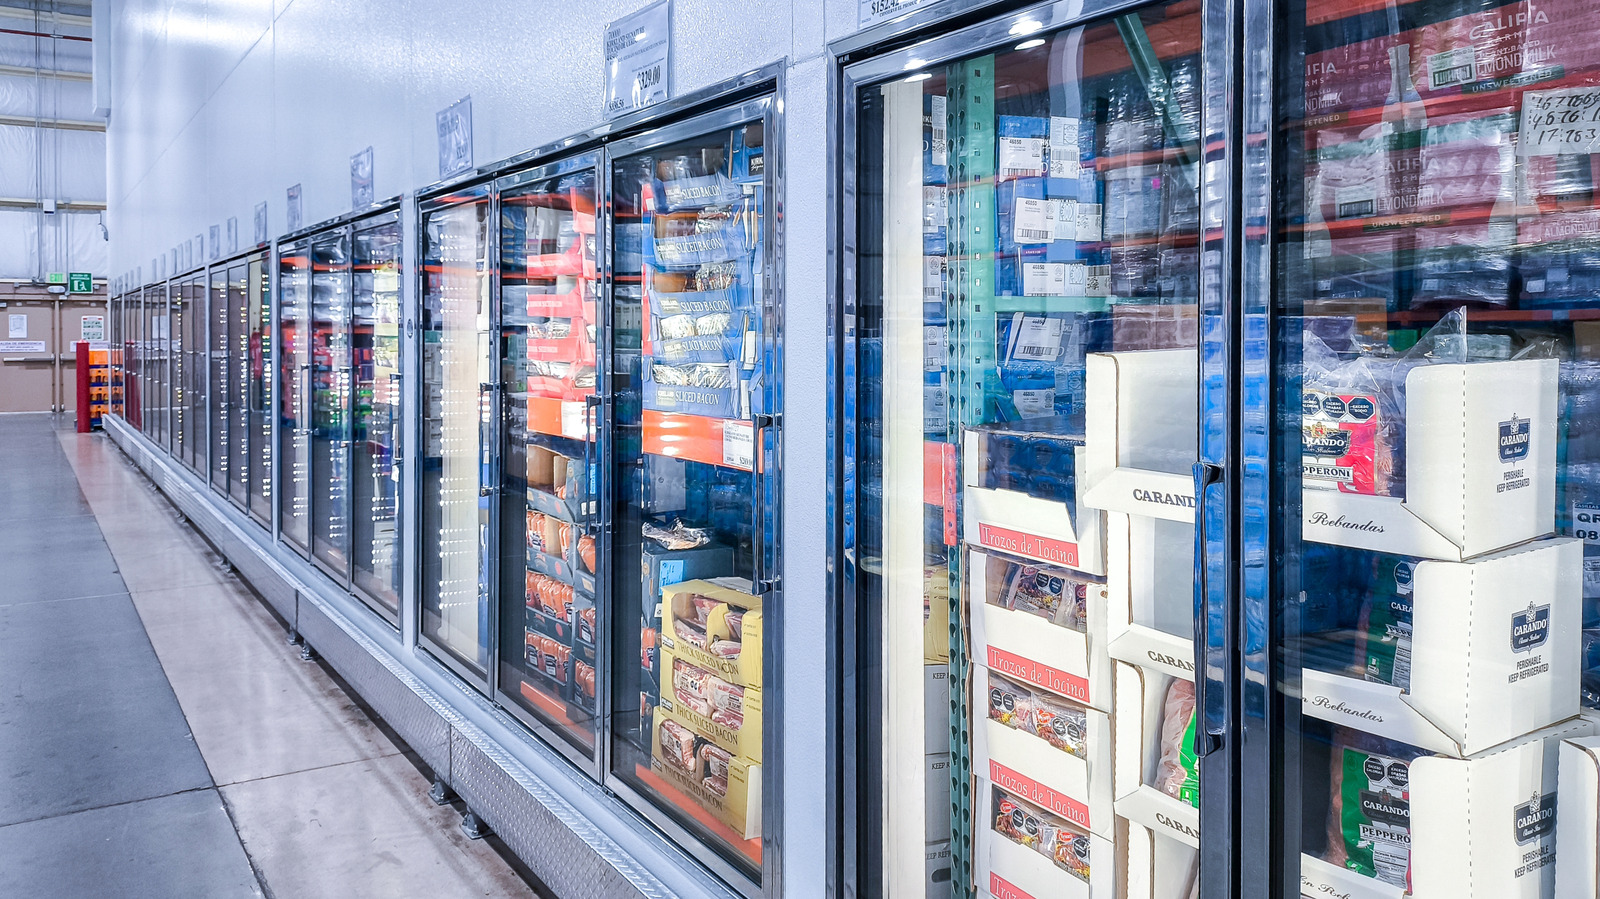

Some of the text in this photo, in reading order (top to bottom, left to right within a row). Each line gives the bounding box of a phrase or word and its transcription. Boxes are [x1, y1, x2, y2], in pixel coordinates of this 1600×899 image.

[1469, 10, 1549, 40] CALIFIA
[1305, 62, 1337, 76] IFIA
[1476, 45, 1557, 75] LMONDMILK
[1384, 157, 1441, 173] ALIFIA
[681, 188, 700, 200] SLICED
[700, 185, 722, 198] BACON
[1377, 188, 1445, 211] LMONDMILK
[676, 240, 697, 254] SLICED
[698, 238, 722, 252] BACON
[680, 301, 704, 312] SLICED
[704, 300, 730, 312] BACON
[700, 340, 722, 352] BACON
[676, 390, 696, 402] SLICED
[696, 394, 720, 405] BACON
[1303, 437, 1345, 448] RANDO
[1501, 432, 1528, 446] CARANDO
[1504, 468, 1524, 482] PERISHABLE
[1496, 478, 1530, 494] KEEP REFRIGERATED
[1133, 488, 1195, 508] CARAND
[1308, 512, 1385, 534] Rebandas
[982, 526, 1074, 564] Trozos de Tocino
[1514, 618, 1547, 636] CARANDO
[677, 640, 740, 676] THICK SLICED BACON
[1516, 654, 1542, 670] PERISHABLE
[990, 648, 1085, 699] Trozos de Tocino
[1508, 662, 1550, 684] KEEP REFRIGERATED
[1312, 696, 1384, 723] Rebandas
[676, 704, 738, 746] THICK SLICED BACON
[992, 764, 1086, 824] Trozos de Tocino
[1363, 800, 1410, 818] CARANDO
[1517, 808, 1552, 828] CARANDO
[1362, 826, 1411, 844] PEPPERO
[1522, 844, 1549, 864] PERISHABLE
[1514, 866, 1526, 878] KEEP
